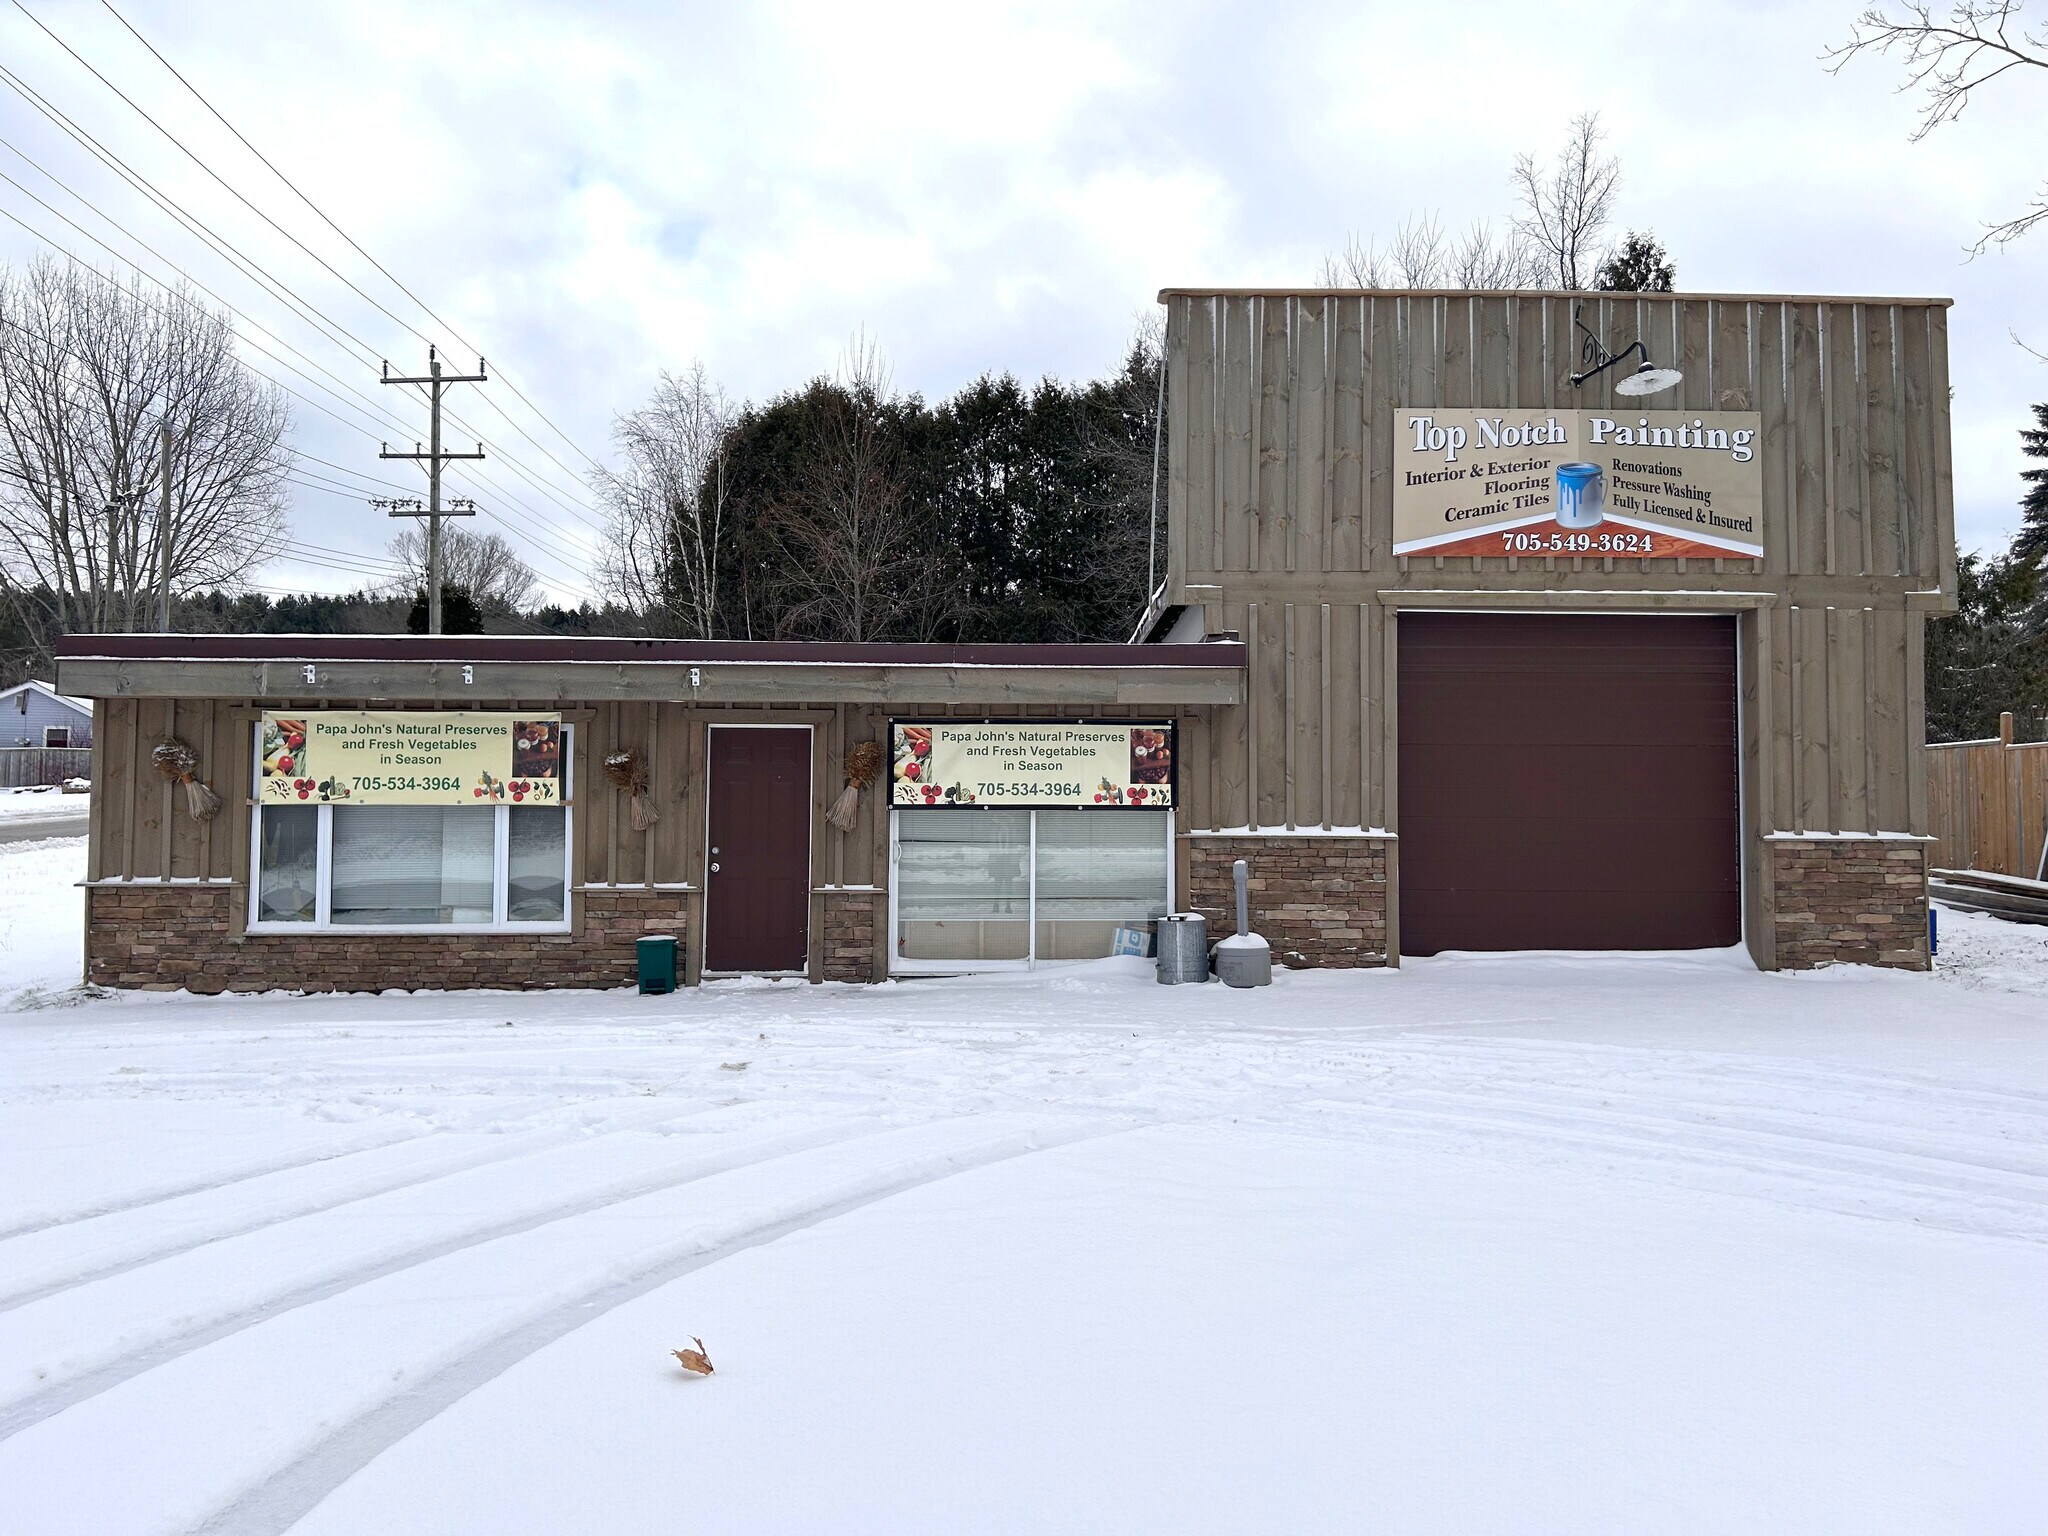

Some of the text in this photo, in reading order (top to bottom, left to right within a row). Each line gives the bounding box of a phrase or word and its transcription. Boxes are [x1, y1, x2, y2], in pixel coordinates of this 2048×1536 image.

[1409, 416, 1755, 462] Top Notch Painting
[1405, 458, 1551, 486] Interior & Exterior
[1612, 458, 1682, 478] Renovations
[1484, 475, 1550, 495] Flooring
[1612, 476, 1712, 507] Pressure Washing
[1445, 493, 1550, 523] Ceramic Tiles
[1612, 494, 1753, 533] Fully Licensed & Insured
[1502, 532, 1653, 553] 705-549-3624
[316, 724, 507, 737] Papa John's Natural Preserves
[941, 731, 1125, 744] Papa John's Natural Preserves
[342, 739, 477, 752] and Fresh Vegetables
[966, 746, 1096, 758] and Fresh Vegetables
[380, 754, 442, 765] in Season
[1003, 760, 1063, 771] in Season
[352, 777, 460, 791] 705-534-3964
[977, 782, 1081, 796] 705-534-3964
